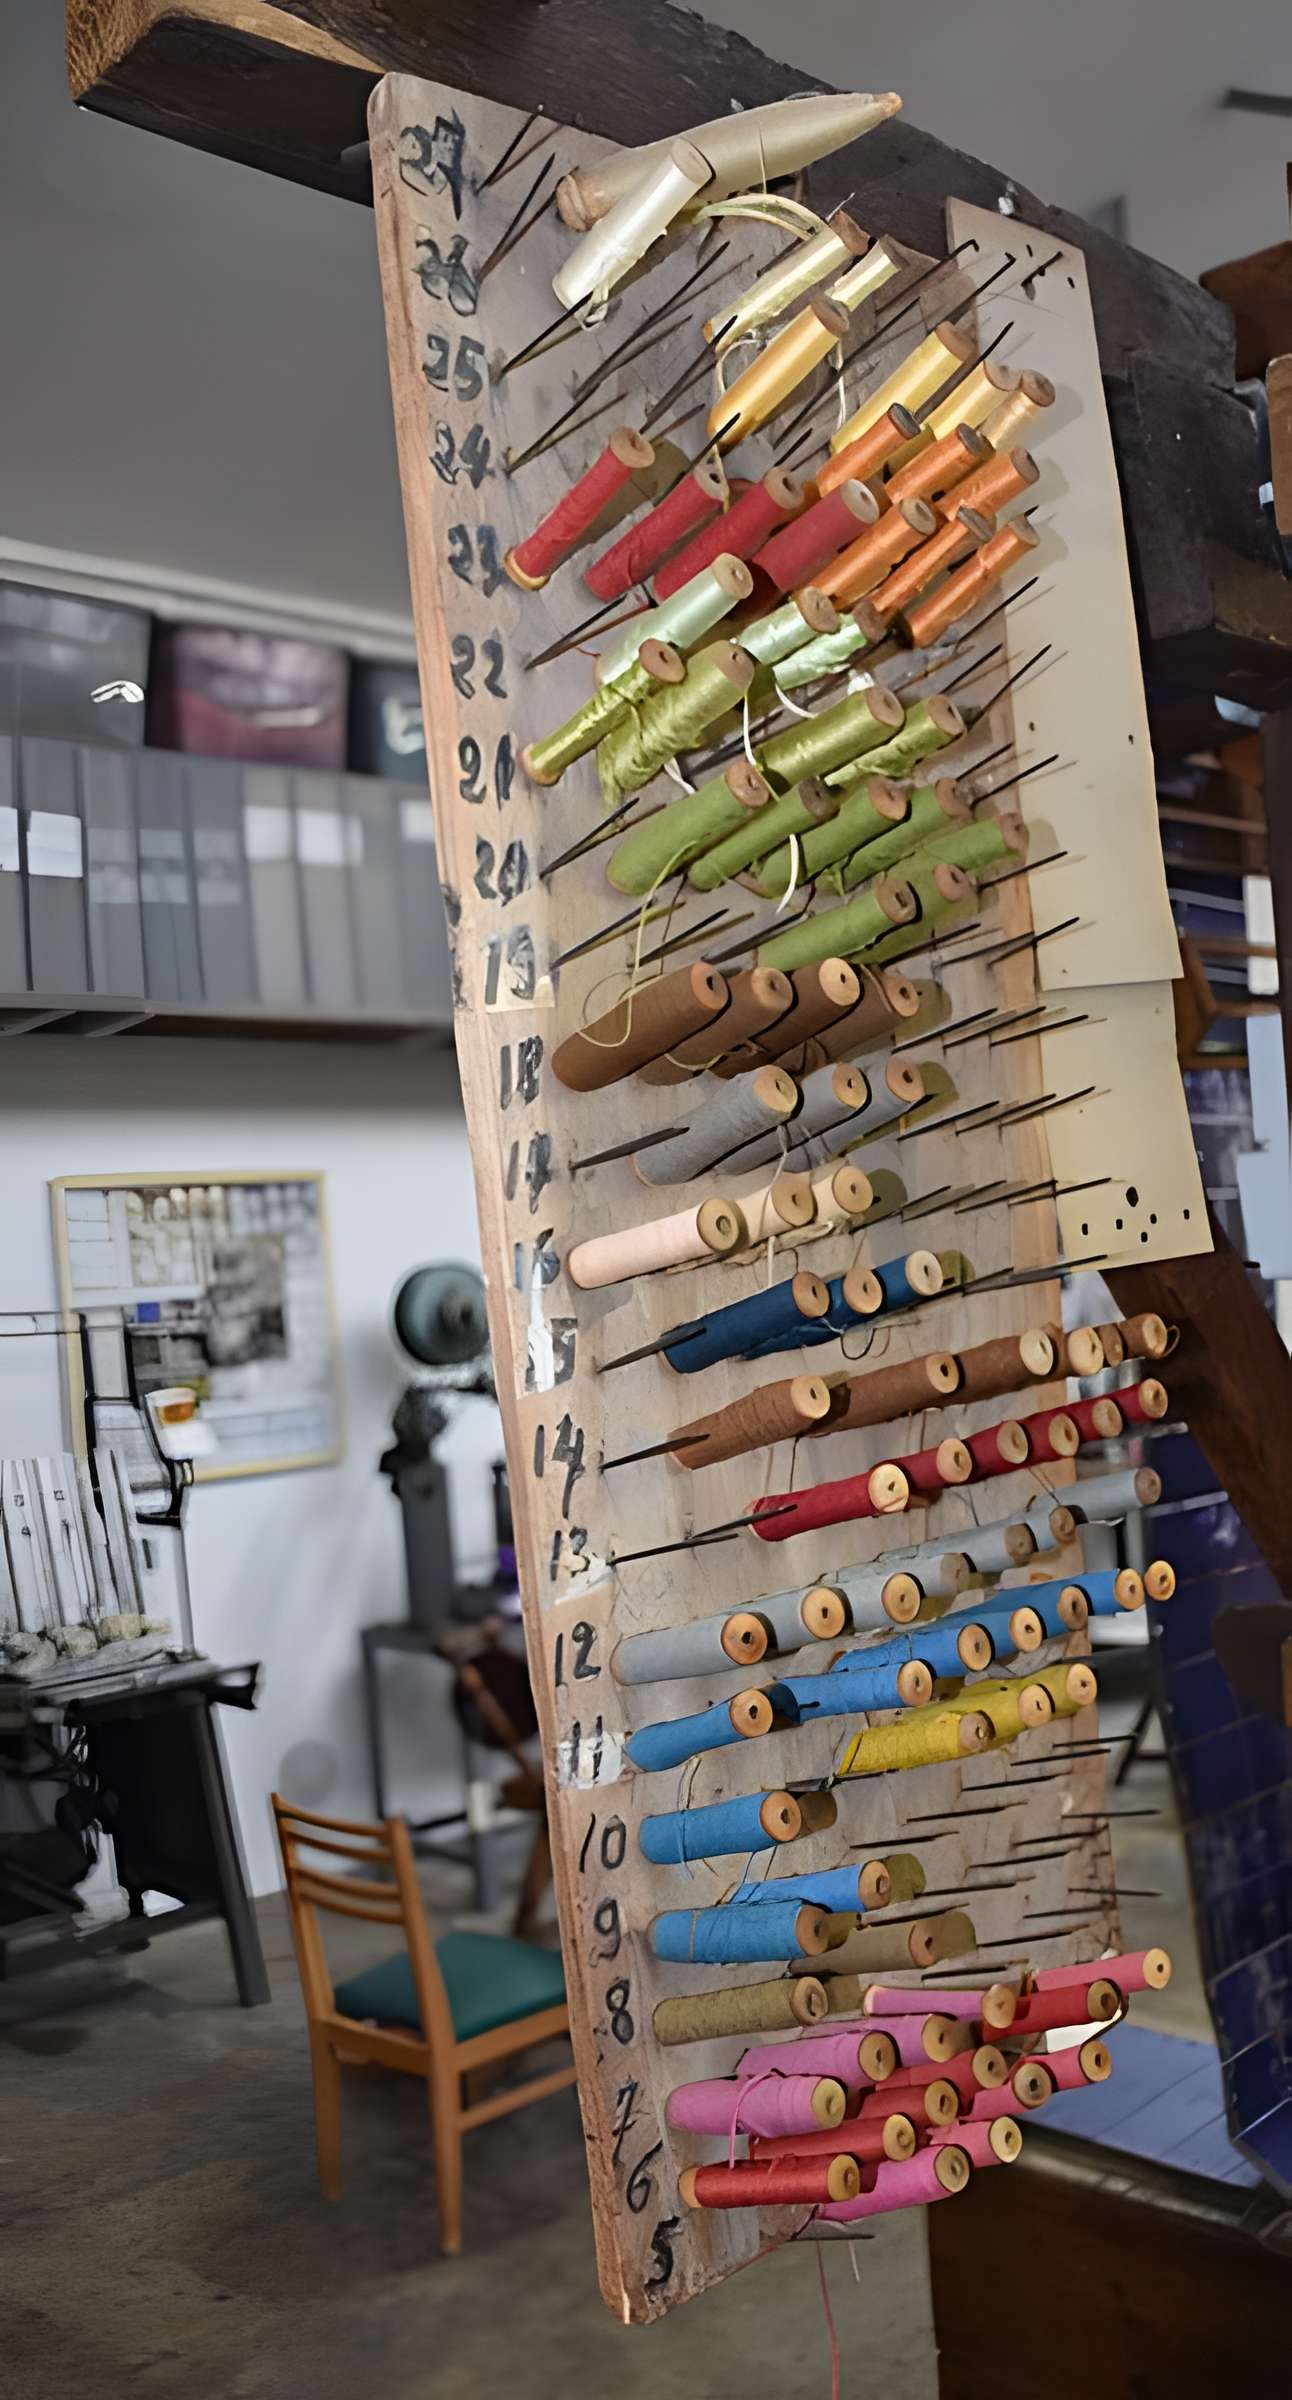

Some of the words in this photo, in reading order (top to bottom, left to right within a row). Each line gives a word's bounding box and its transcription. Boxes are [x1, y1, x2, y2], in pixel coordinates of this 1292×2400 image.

[422, 333, 484, 401] 25
[429, 420, 496, 491] 24
[450, 634, 508, 700] 22
[458, 732, 516, 811] 21
[474, 834, 530, 907] 20
[534, 1413, 586, 1519] 14
[551, 1526, 590, 1581] 13
[555, 1621, 602, 1687] 12
[570, 1716, 604, 1785] 11
[579, 1812, 627, 1874] 10
[593, 1897, 622, 1961] 9
[605, 1976, 635, 2046] 8
[611, 2075, 640, 2165] 7
[626, 2139, 664, 2214] 6
[644, 2220, 681, 2294] 5
